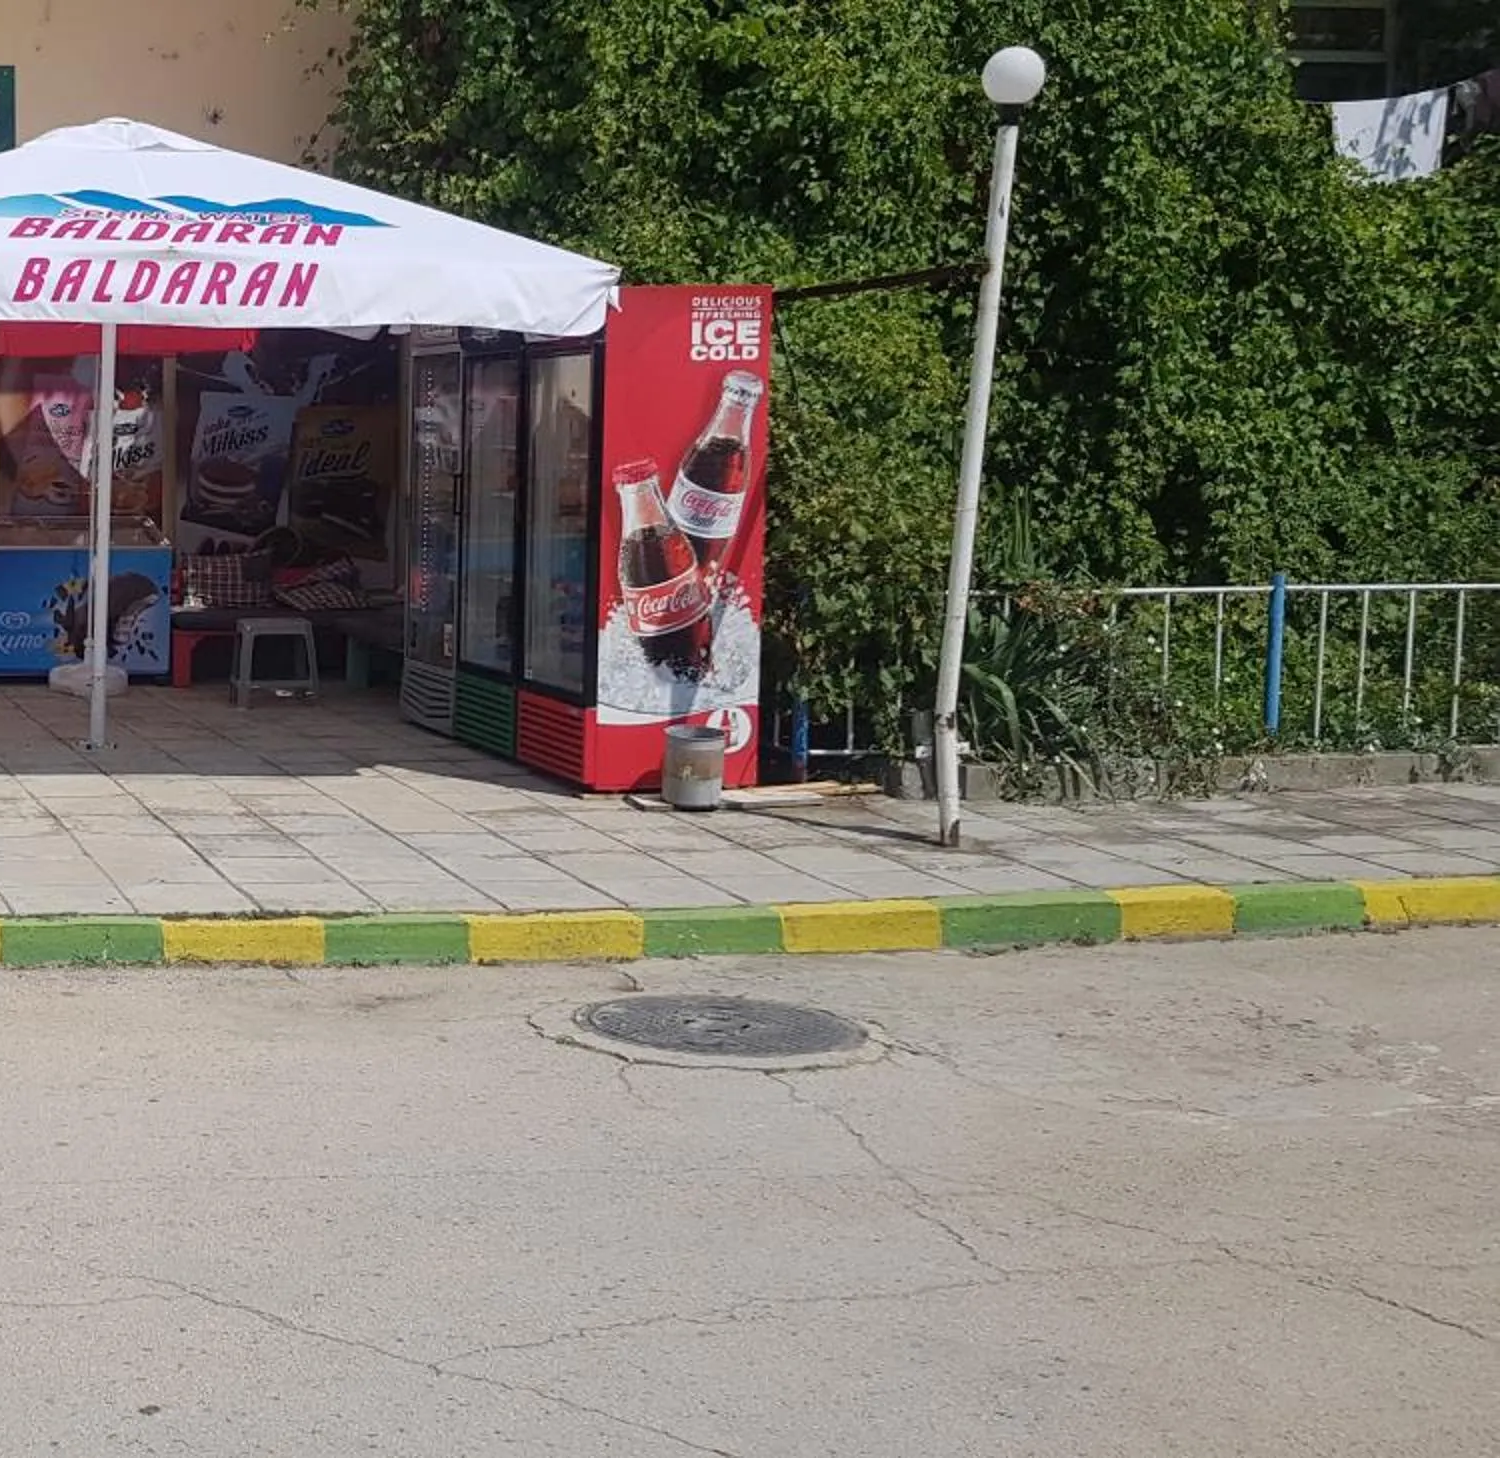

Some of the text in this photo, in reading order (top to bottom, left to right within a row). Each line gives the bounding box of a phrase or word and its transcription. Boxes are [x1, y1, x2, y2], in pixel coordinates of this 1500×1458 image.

[58, 207, 314, 226] SPRING WATER
[8, 216, 344, 246] BALDARAN
[12, 257, 319, 307] BALDARAN
[691, 295, 761, 307] DELICIOUS
[691, 319, 761, 345] ICE
[690, 345, 760, 361] COLD
